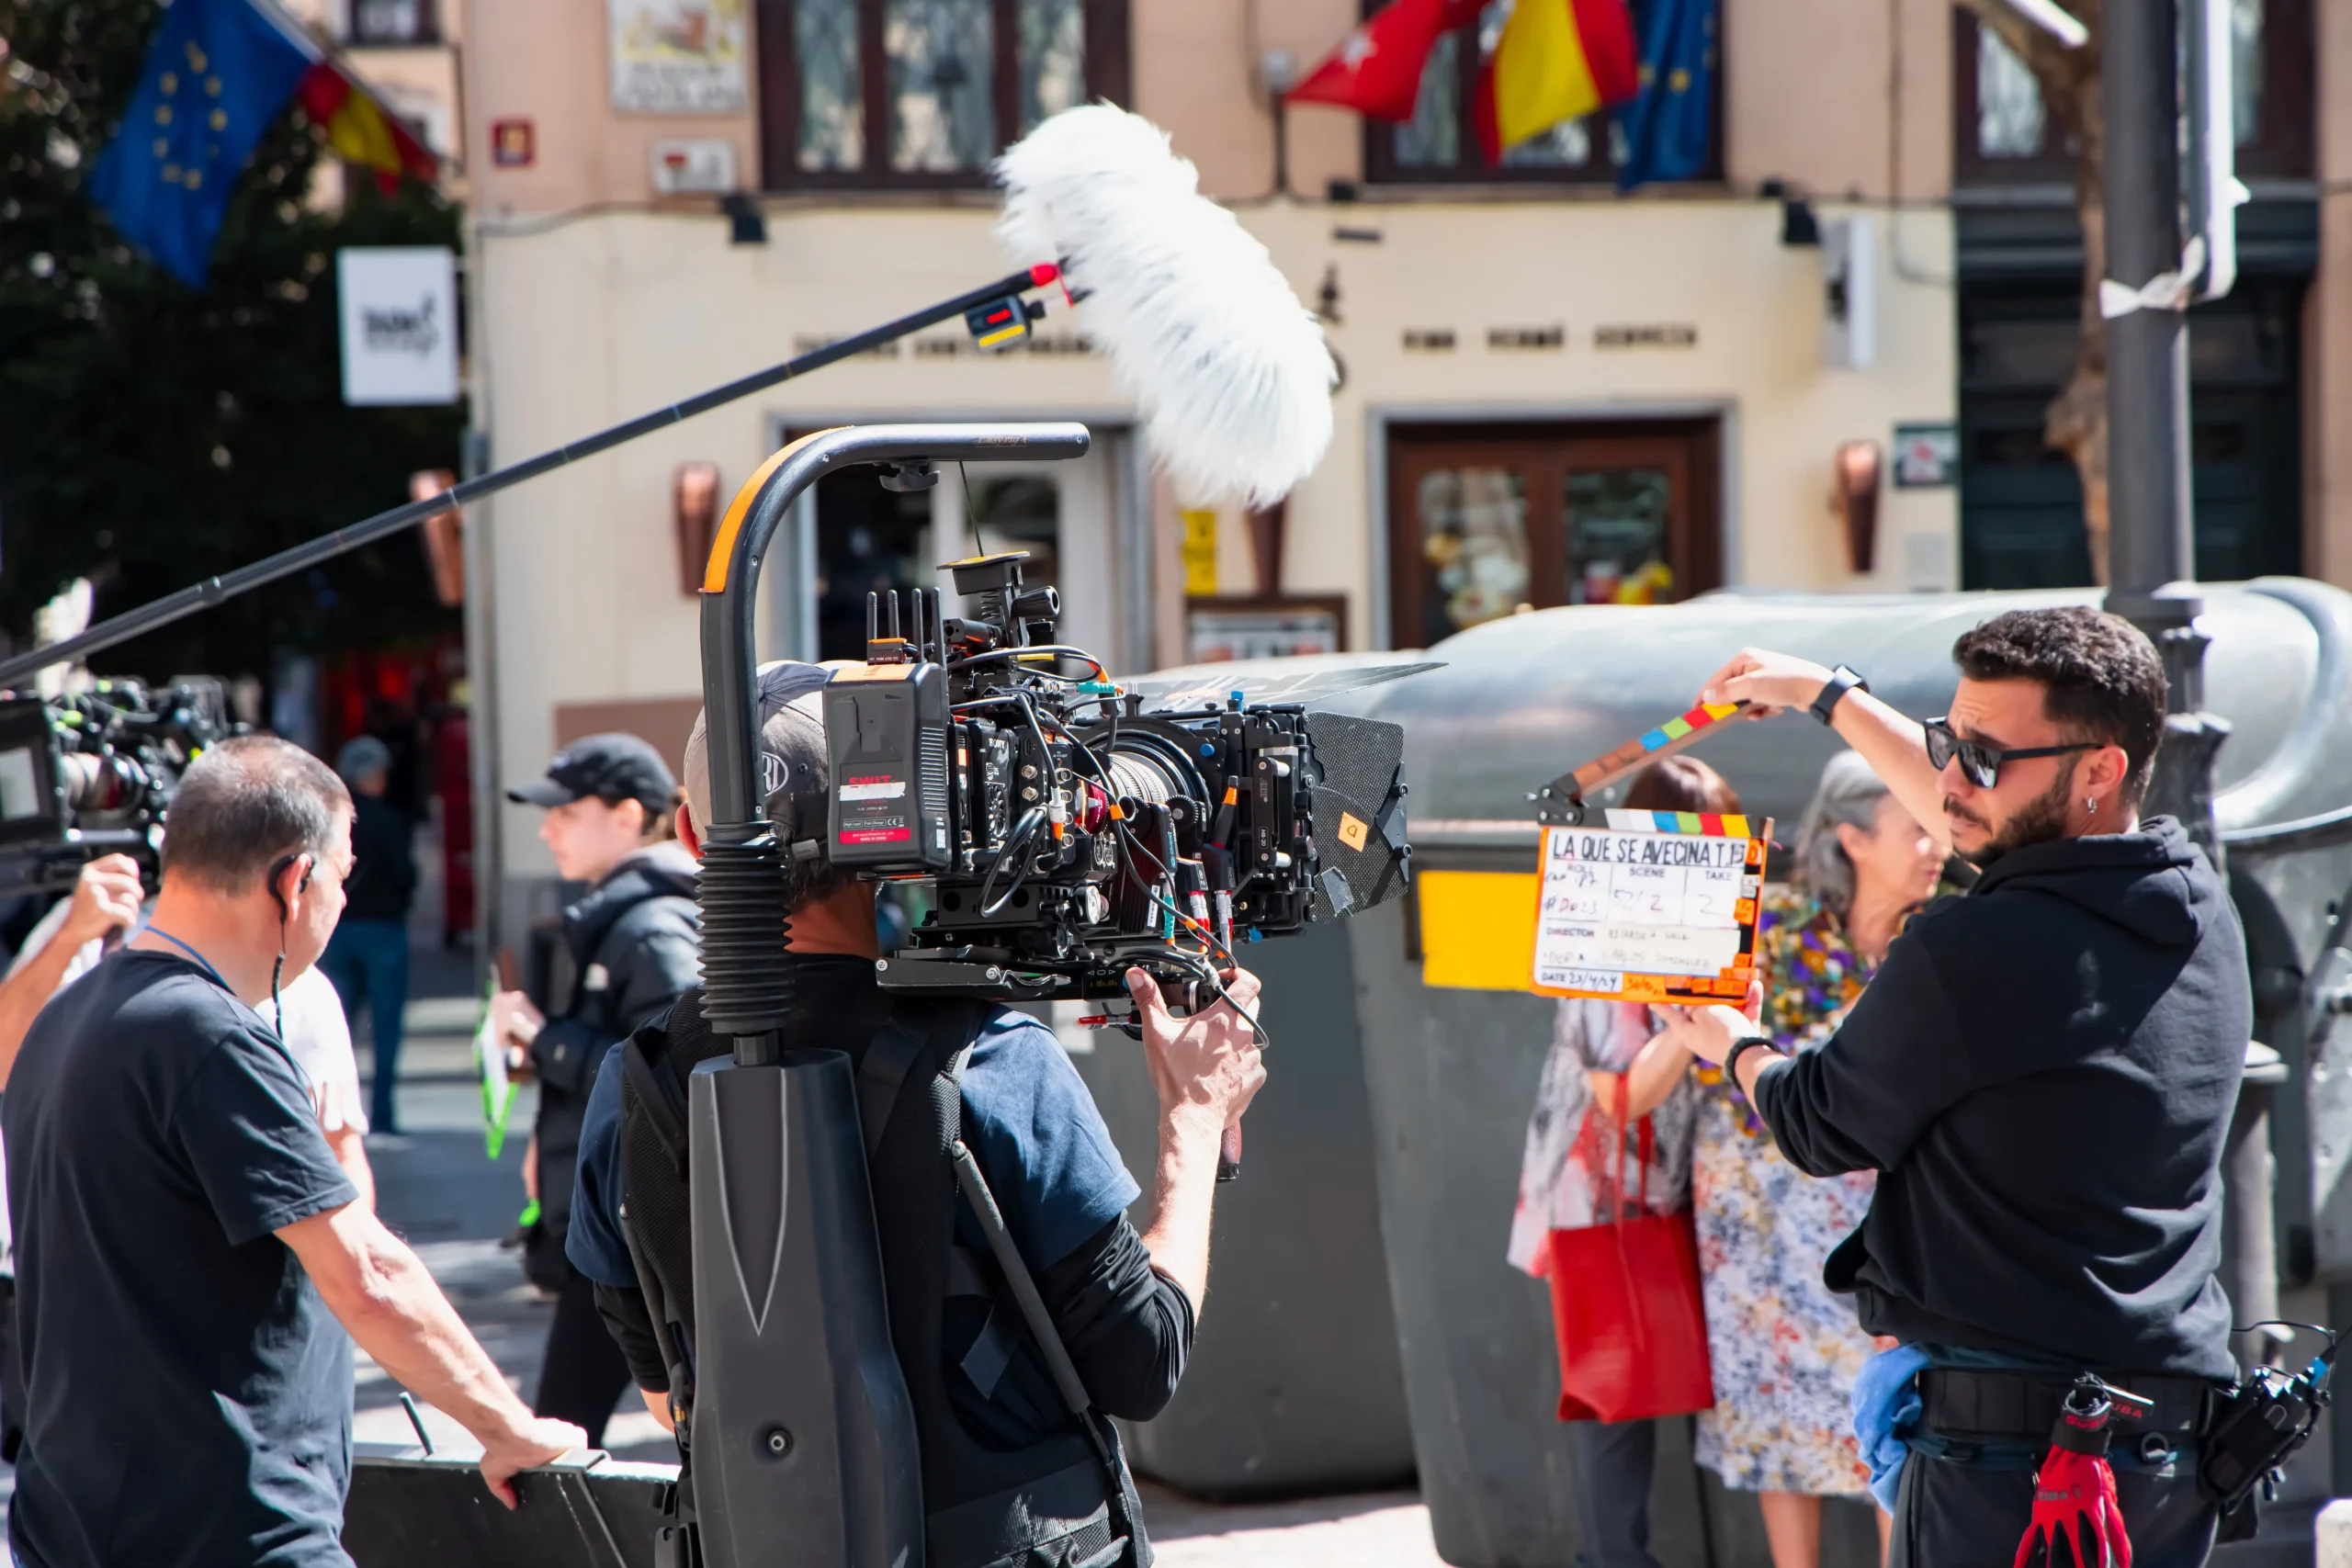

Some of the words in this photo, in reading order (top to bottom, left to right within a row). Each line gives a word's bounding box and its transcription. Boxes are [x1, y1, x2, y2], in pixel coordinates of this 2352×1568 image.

[1553, 834, 1576, 858] LA
[1581, 835, 1611, 862] QUE
[1617, 838, 1638, 863] SE
[1641, 839, 1711, 866] AVECINA
[1629, 866, 1666, 878] SCENE
[1705, 870, 1732, 881] TAKE
[1546, 927, 1595, 938] DIRECTOR
[1542, 972, 1566, 982] DATE
